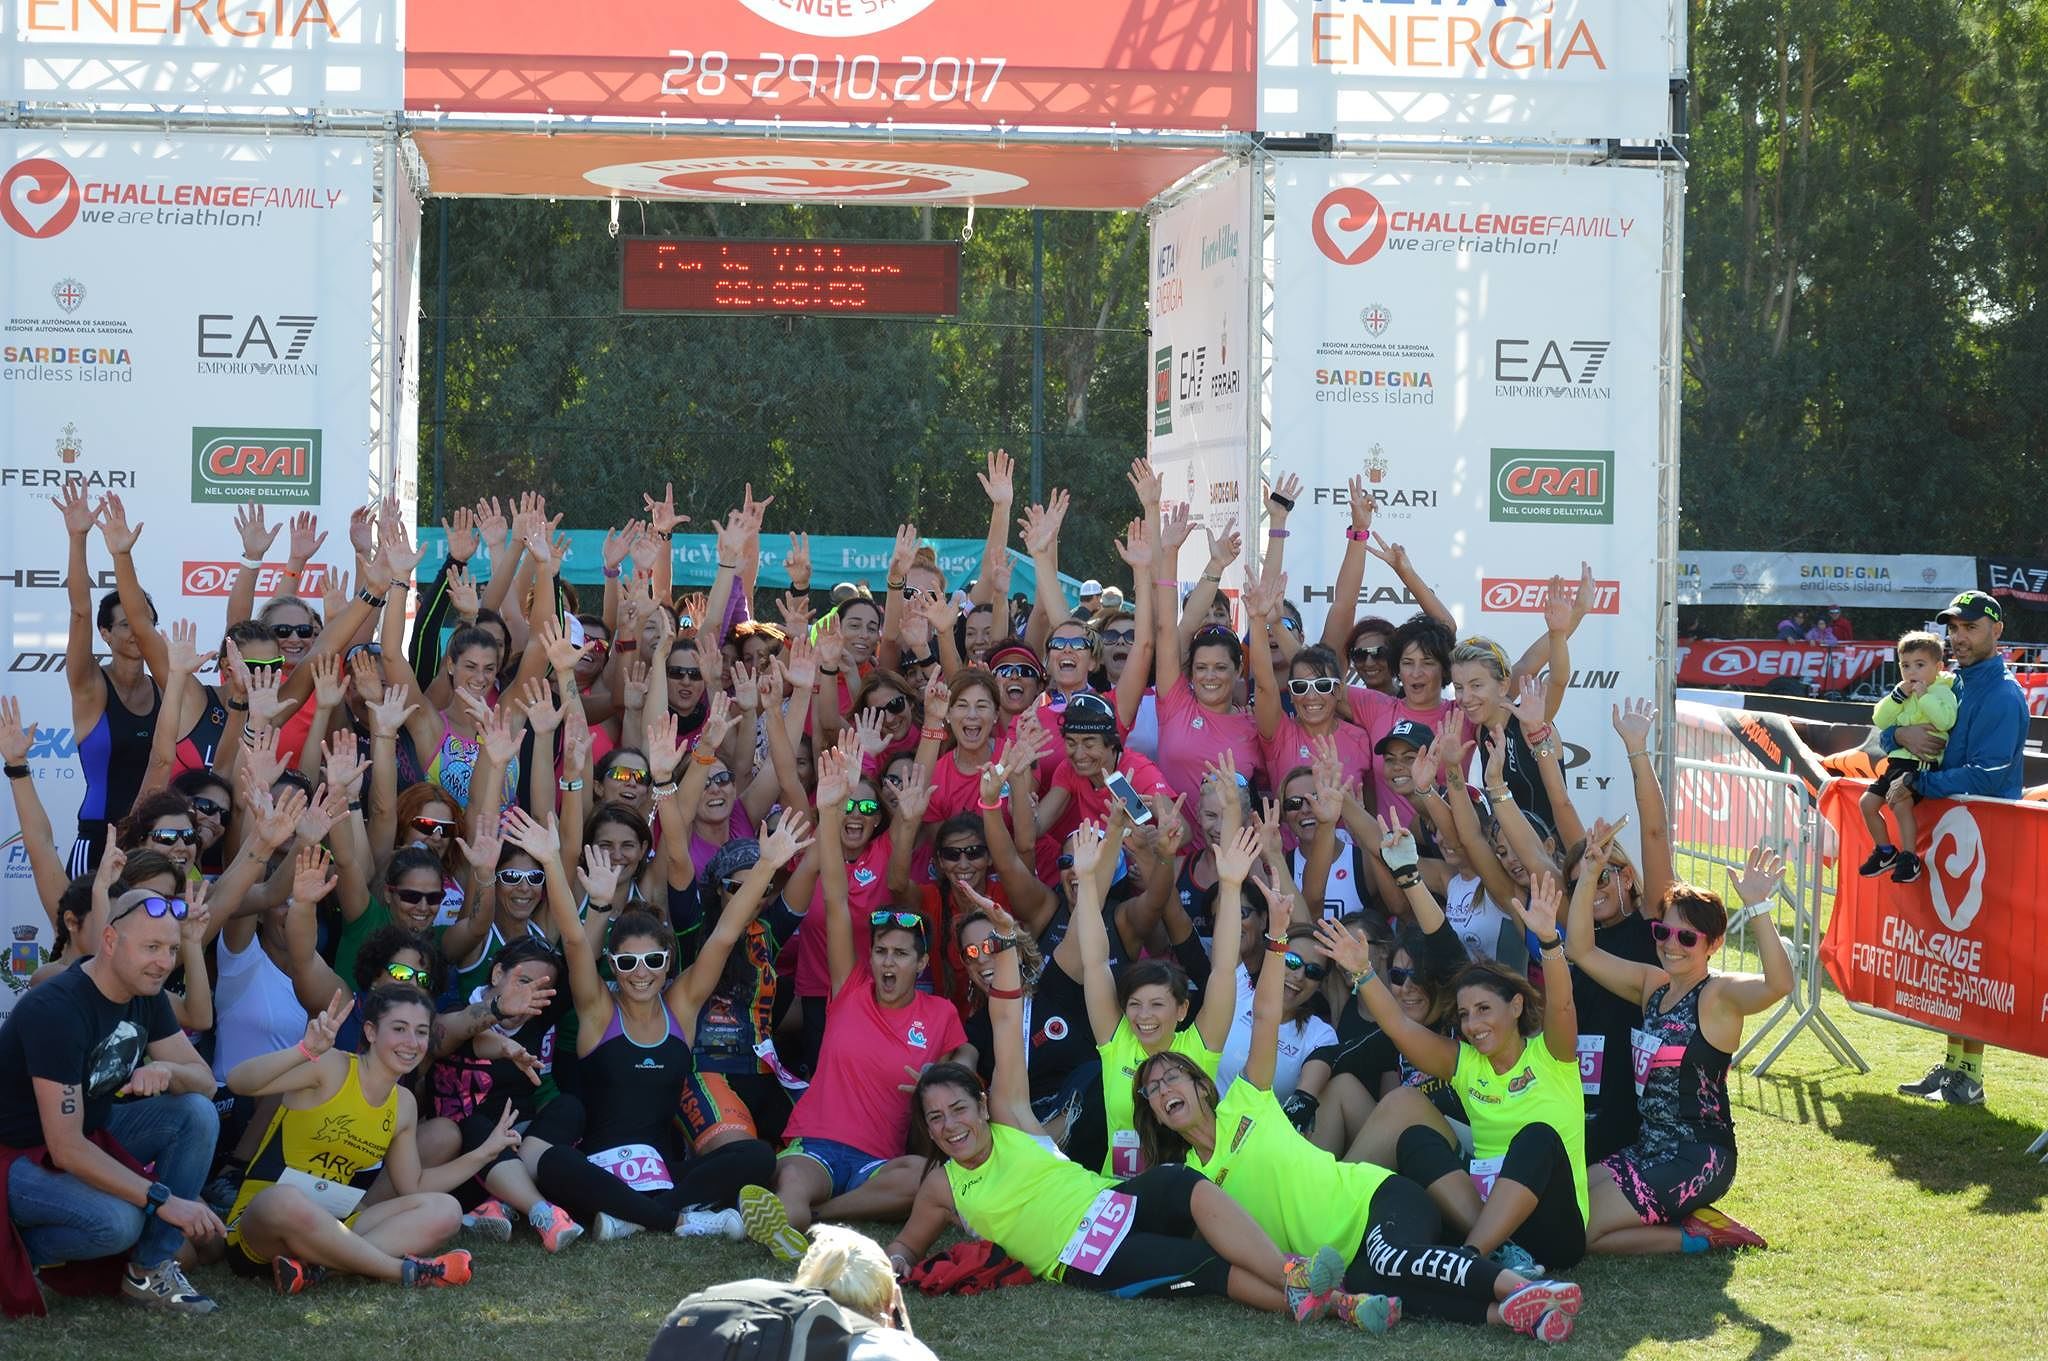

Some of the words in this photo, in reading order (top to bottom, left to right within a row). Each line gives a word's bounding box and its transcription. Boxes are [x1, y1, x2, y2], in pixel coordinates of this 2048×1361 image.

[661, 48, 1008, 104] 28-29.10.2017
[198, 314, 318, 360] EA7
[3, 346, 131, 365] SARDEGNA
[1495, 338, 1611, 384] EA7
[3, 364, 73, 381] endless
[79, 365, 132, 383] island
[198, 361, 254, 375] EMPORIO
[272, 363, 319, 376] ARMANI
[1315, 369, 1433, 388] SARDEGNA
[1315, 387, 1379, 403] endless
[1384, 388, 1434, 405] island
[1495, 384, 1549, 398] EMPORIO
[1564, 387, 1611, 399] ARMANI
[209, 445, 306, 477] CRAI
[204, 487, 222, 496] NEL
[224, 487, 257, 496] CUORE
[257, 488, 310, 497] DELL'ITALIA
[1506, 466, 1600, 497] CRAI
[1502, 506, 1520, 515] NEL
[1521, 506, 1552, 516] CUORE
[1553, 507, 1603, 516] DELL'ITALIA
[1799, 581, 1850, 592] endless
[1853, 581, 1892, 593] island
[1989, 564, 2048, 593] EA7
[56, 768, 75, 780] TO
[1882, 915, 1983, 973] CHALLENGE
[1580, 1053, 1595, 1077] 5
[1081, 1200, 1126, 1258] 115
[1411, 1248, 1473, 1288] KEEP
